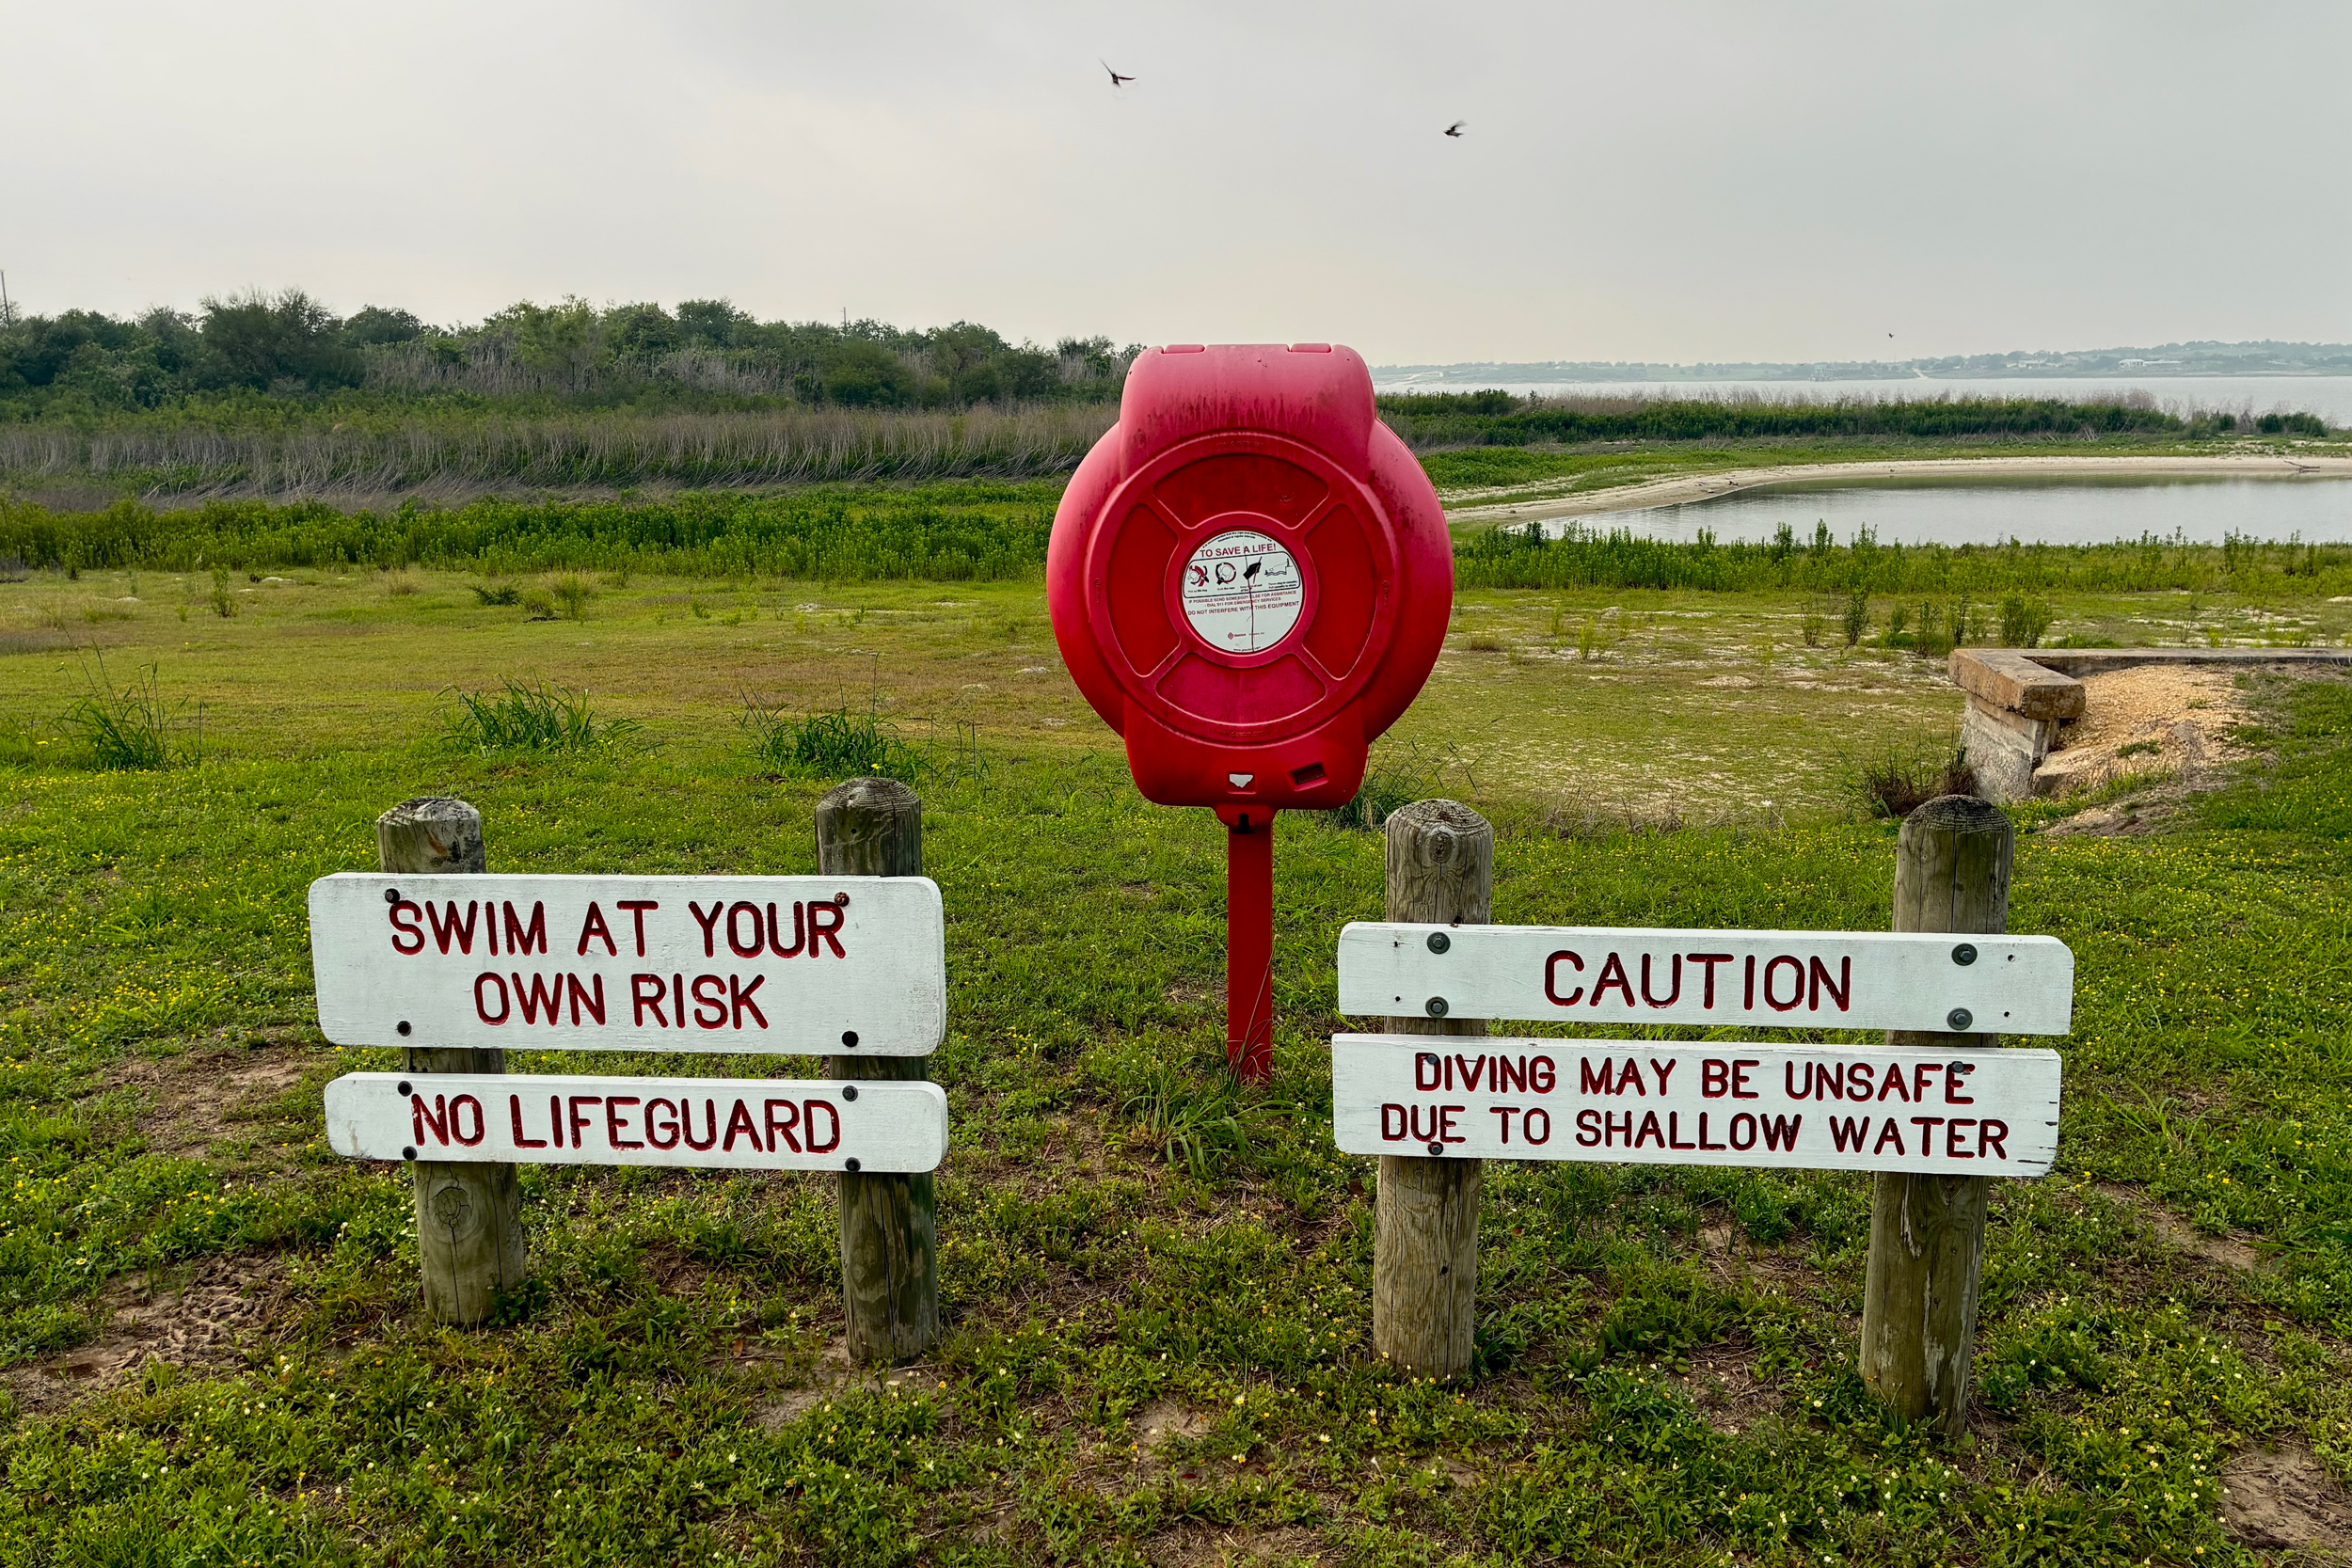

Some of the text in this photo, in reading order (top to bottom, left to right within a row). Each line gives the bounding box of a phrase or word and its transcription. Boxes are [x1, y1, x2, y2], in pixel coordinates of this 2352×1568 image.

[1200, 543, 1277, 558] TO SAVE A LIFE!
[1267, 600, 1299, 610] EQUIPMENT
[389, 900, 847, 960] SWIM AT YOUR
[473, 972, 770, 1031] OWN RISK
[1544, 949, 1851, 1013] CAUTION
[1414, 1052, 1976, 1105] DIVING MAY BE UNSAFE
[410, 1093, 842, 1155] NO LIFEGUARD
[1380, 1103, 2010, 1160] DUE TO SHALLOW WATER
